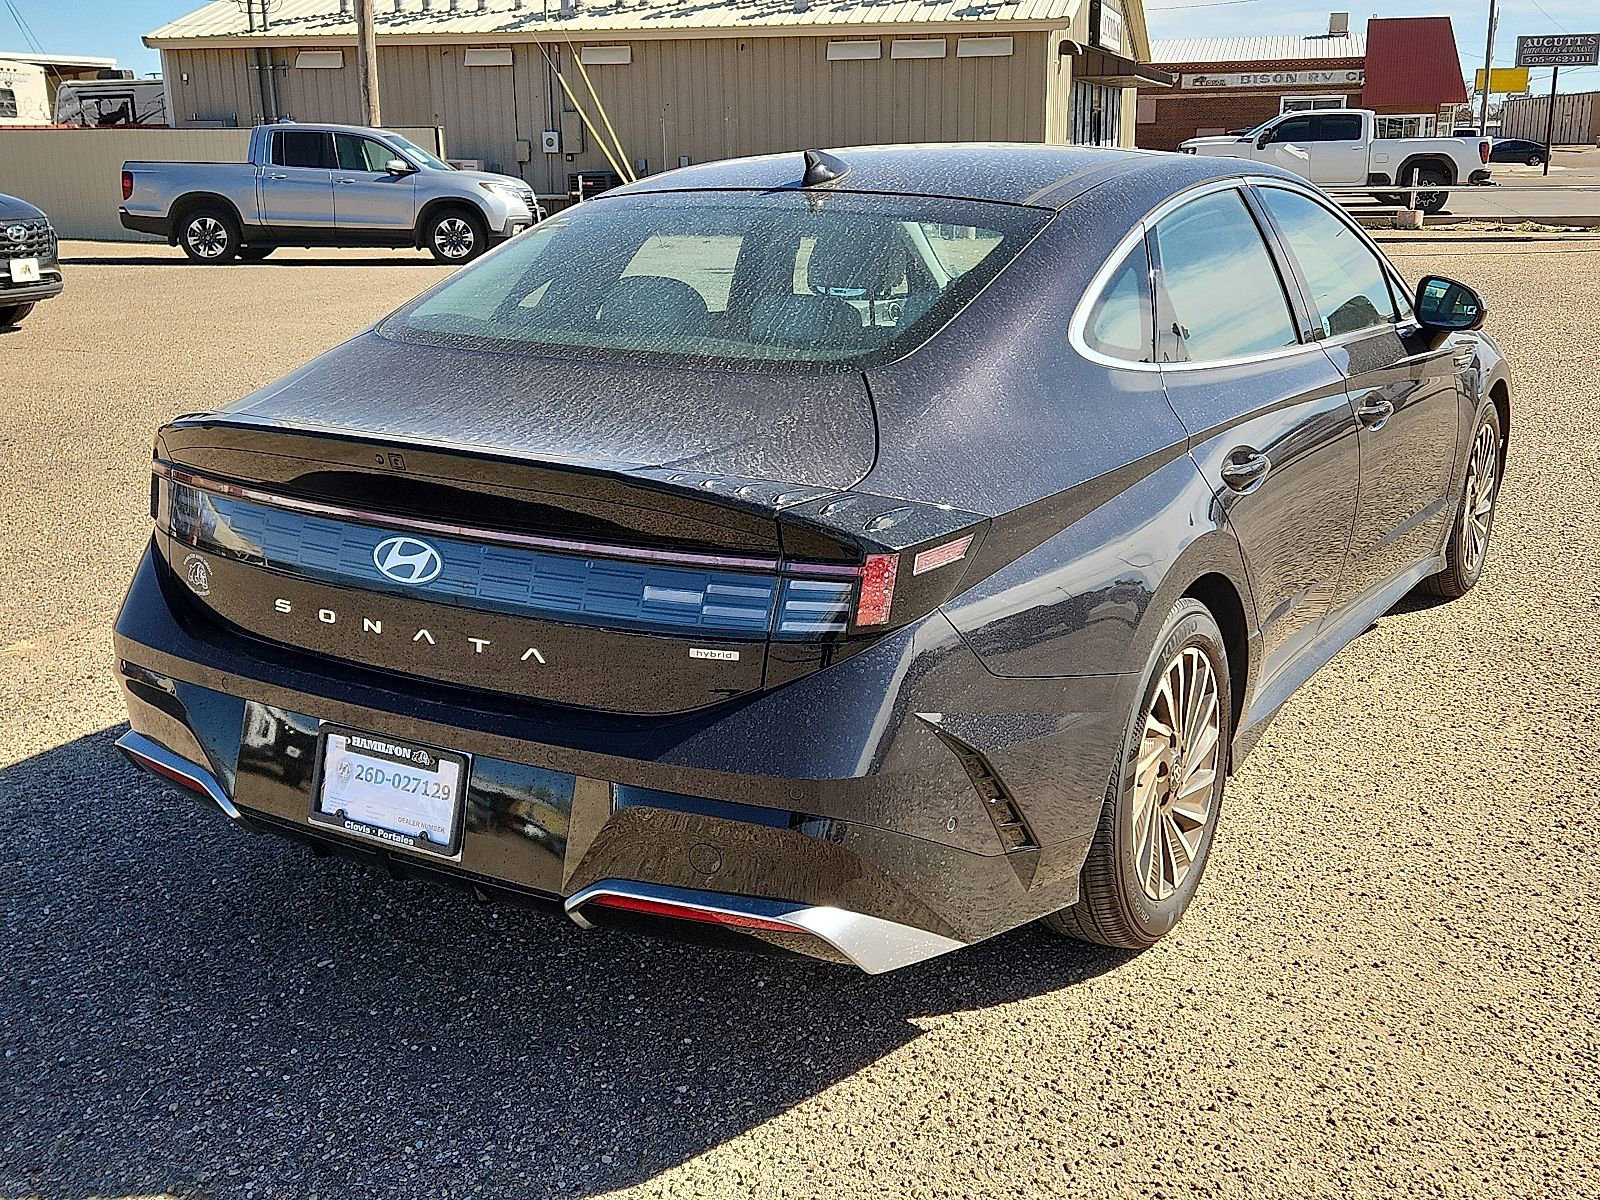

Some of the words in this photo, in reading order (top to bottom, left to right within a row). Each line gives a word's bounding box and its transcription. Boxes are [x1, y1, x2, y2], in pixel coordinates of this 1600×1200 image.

[1523, 37, 1596, 47] AUCUTT'S
[1541, 46, 1560, 54] SALES
[1525, 55, 1590, 63] 505-762-1111
[1240, 73, 1298, 84] BISON
[1308, 72, 1334, 82] RV
[274, 598, 546, 664] SONATA
[696, 650, 732, 659] hybrid
[351, 736, 412, 759] HAMILTON
[354, 764, 451, 801] 26D-027129
[344, 820, 371, 834] Clovis
[377, 828, 414, 846] Portales
